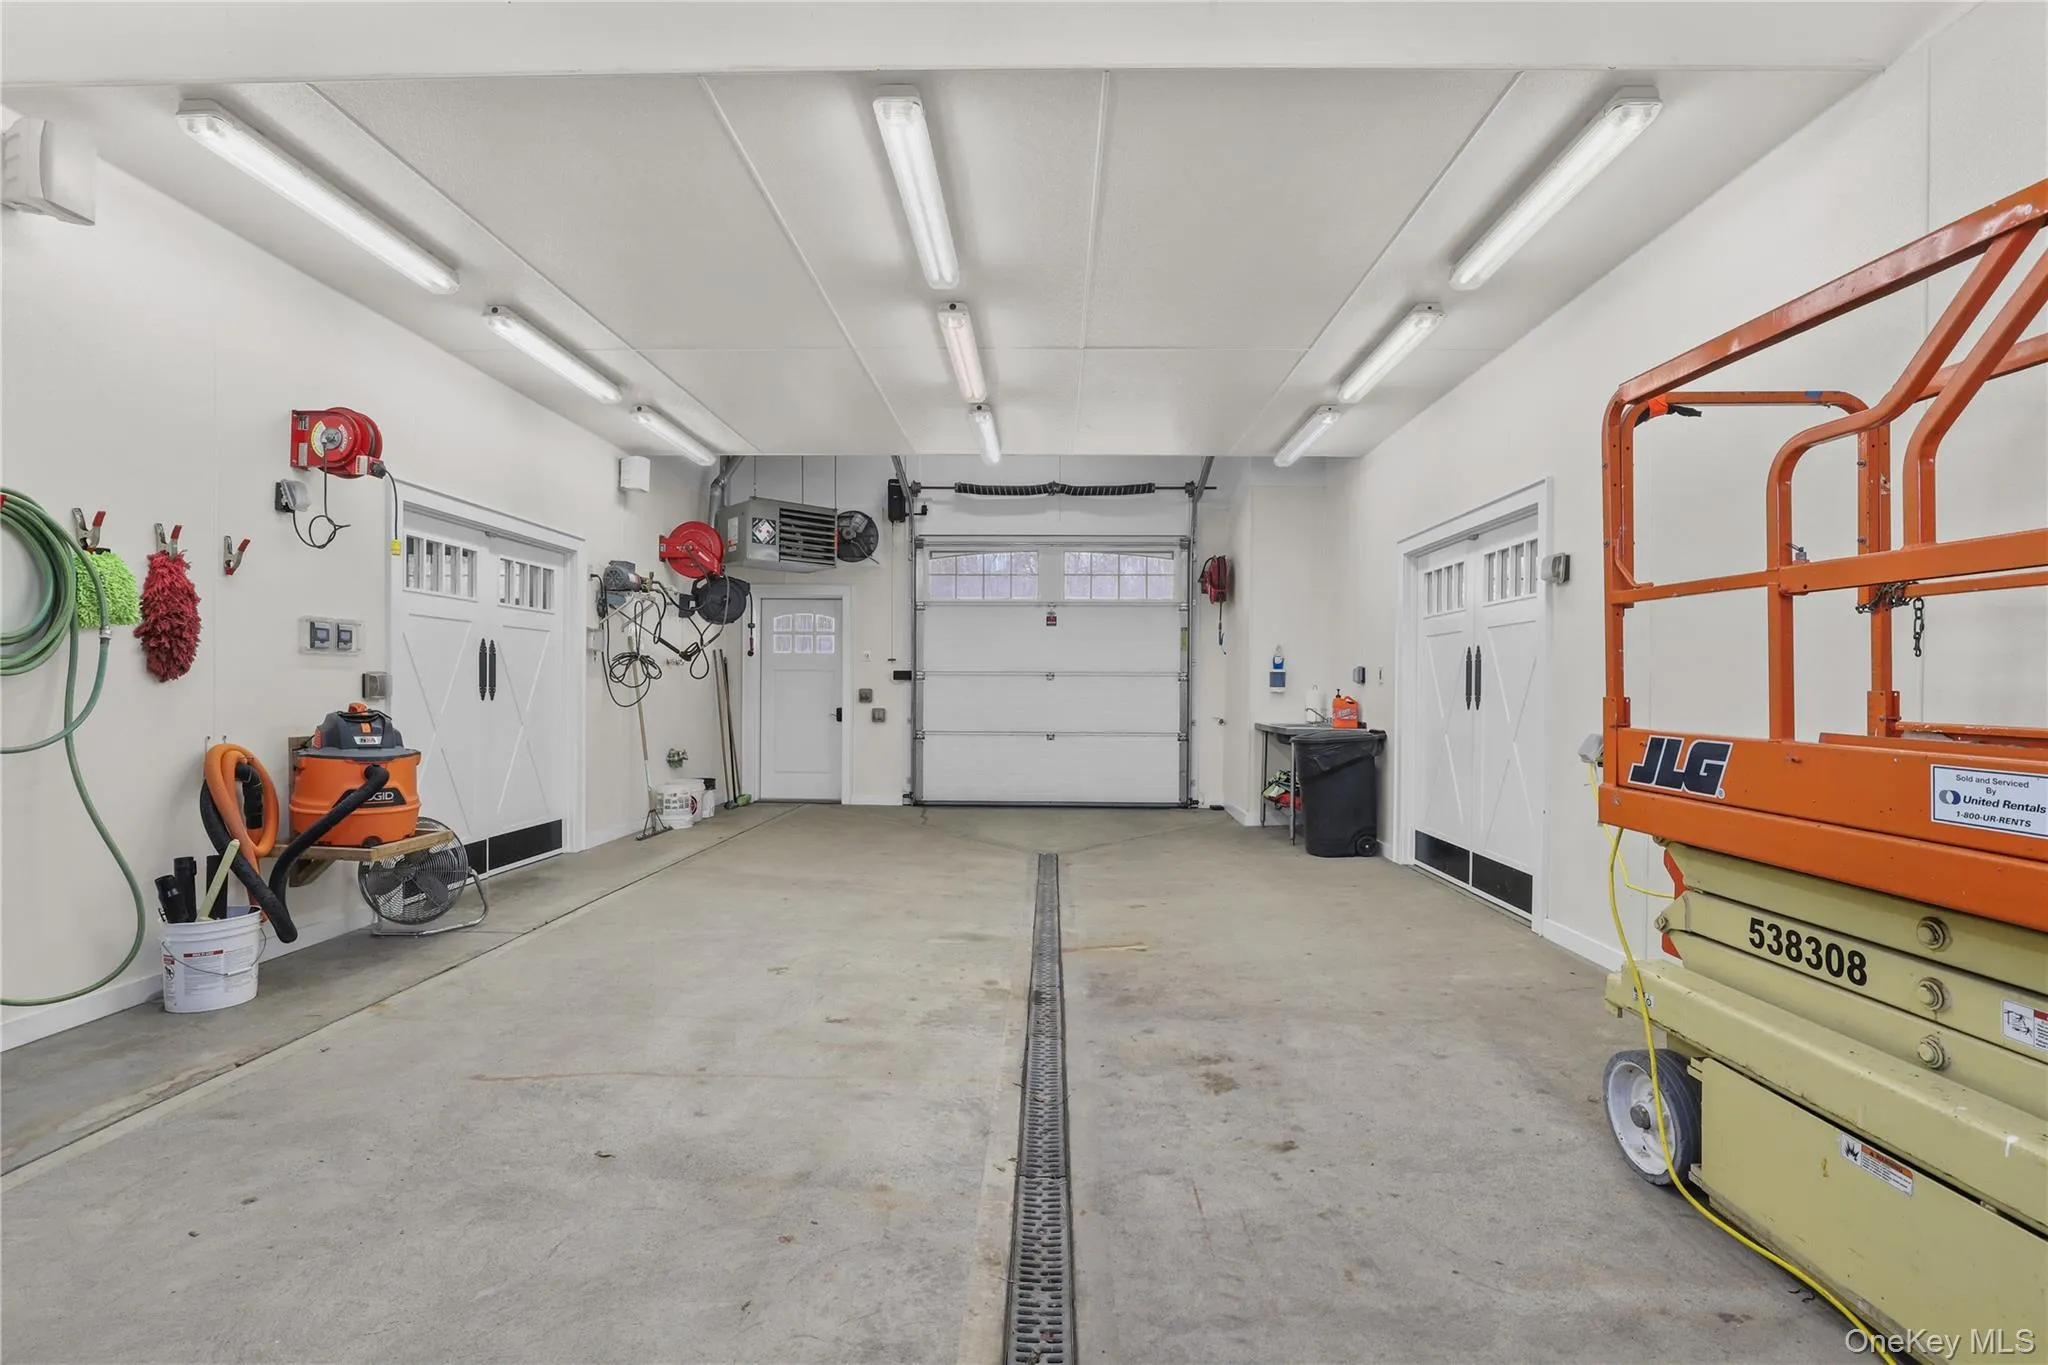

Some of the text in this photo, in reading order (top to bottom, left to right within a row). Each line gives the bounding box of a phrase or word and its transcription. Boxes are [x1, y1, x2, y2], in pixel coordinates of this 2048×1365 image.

[1629, 735, 1733, 798] JLG
[1955, 774, 2029, 788] Sold and Serviced
[1985, 787, 1997, 796] By
[1963, 795, 2047, 814] United Rentals
[1956, 810, 2031, 827] 1-800-UR-RENTS
[1749, 917, 1868, 987] 538308
